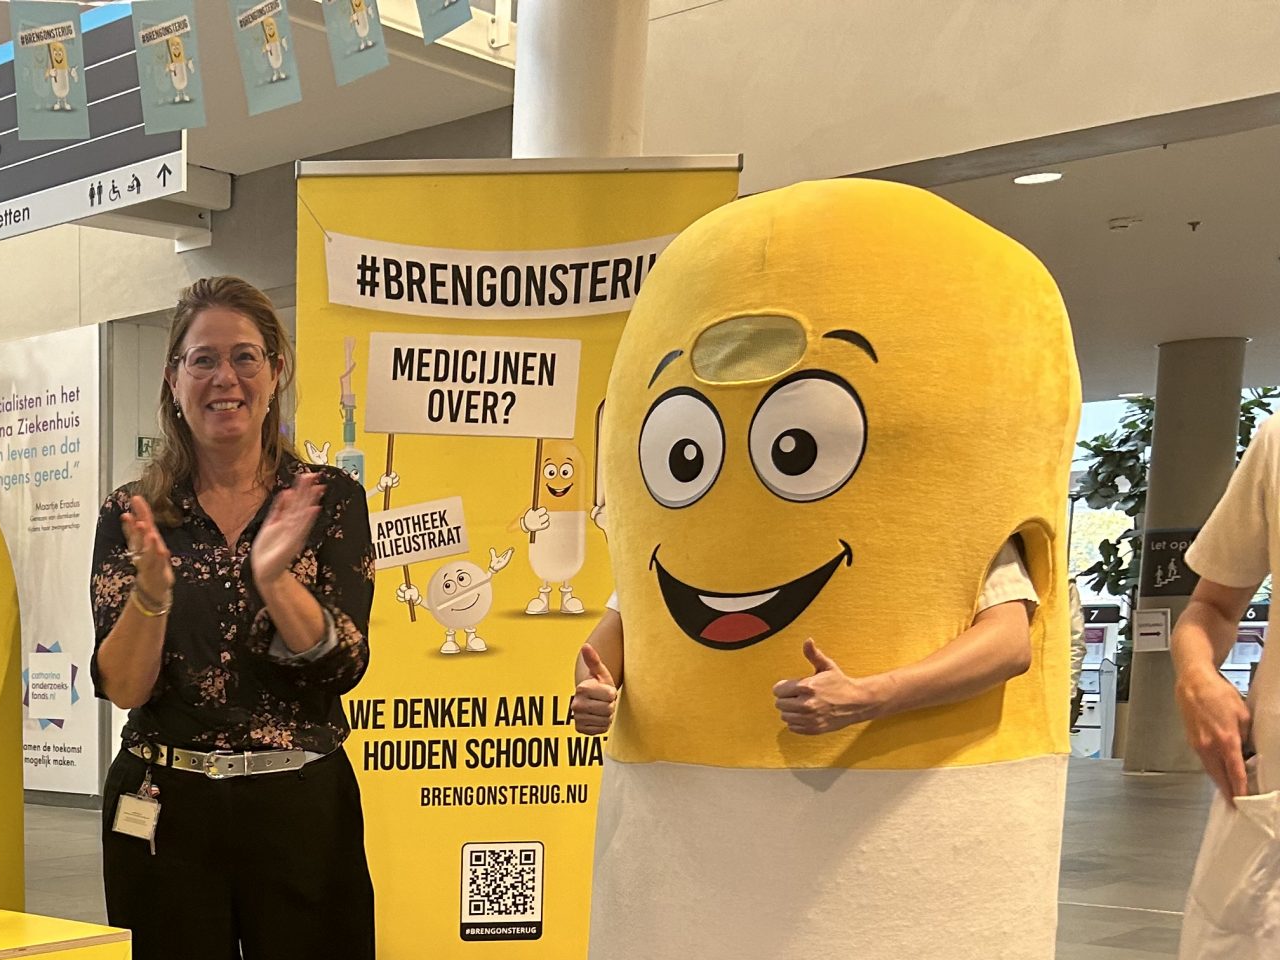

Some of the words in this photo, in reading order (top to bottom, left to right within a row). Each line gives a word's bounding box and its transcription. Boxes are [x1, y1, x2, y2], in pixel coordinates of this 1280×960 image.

[357, 253, 657, 308] #BRENGONSTERU
[392, 347, 556, 387] MEDICIJNEN
[46, 389, 57, 406] in
[61, 385, 80, 403] het
[427, 389, 516, 425] OVER?
[17, 411, 80, 436] Ziekenhuis
[7, 443, 37, 461] leven
[42, 443, 56, 456] en
[60, 436, 80, 454] dat
[377, 509, 449, 540] APOTHEEK
[1089, 609, 1099, 621] 7
[1246, 607, 1256, 619] 6
[349, 698, 386, 730] WE
[393, 697, 487, 729] DENKEN
[495, 696, 544, 726] AAN
[364, 739, 457, 771] HOUDEN
[465, 737, 558, 769] SCHOON
[420, 784, 588, 807] BRENGONSTERUG.NU
[465, 926, 537, 935] #BRENGONSTERUG
